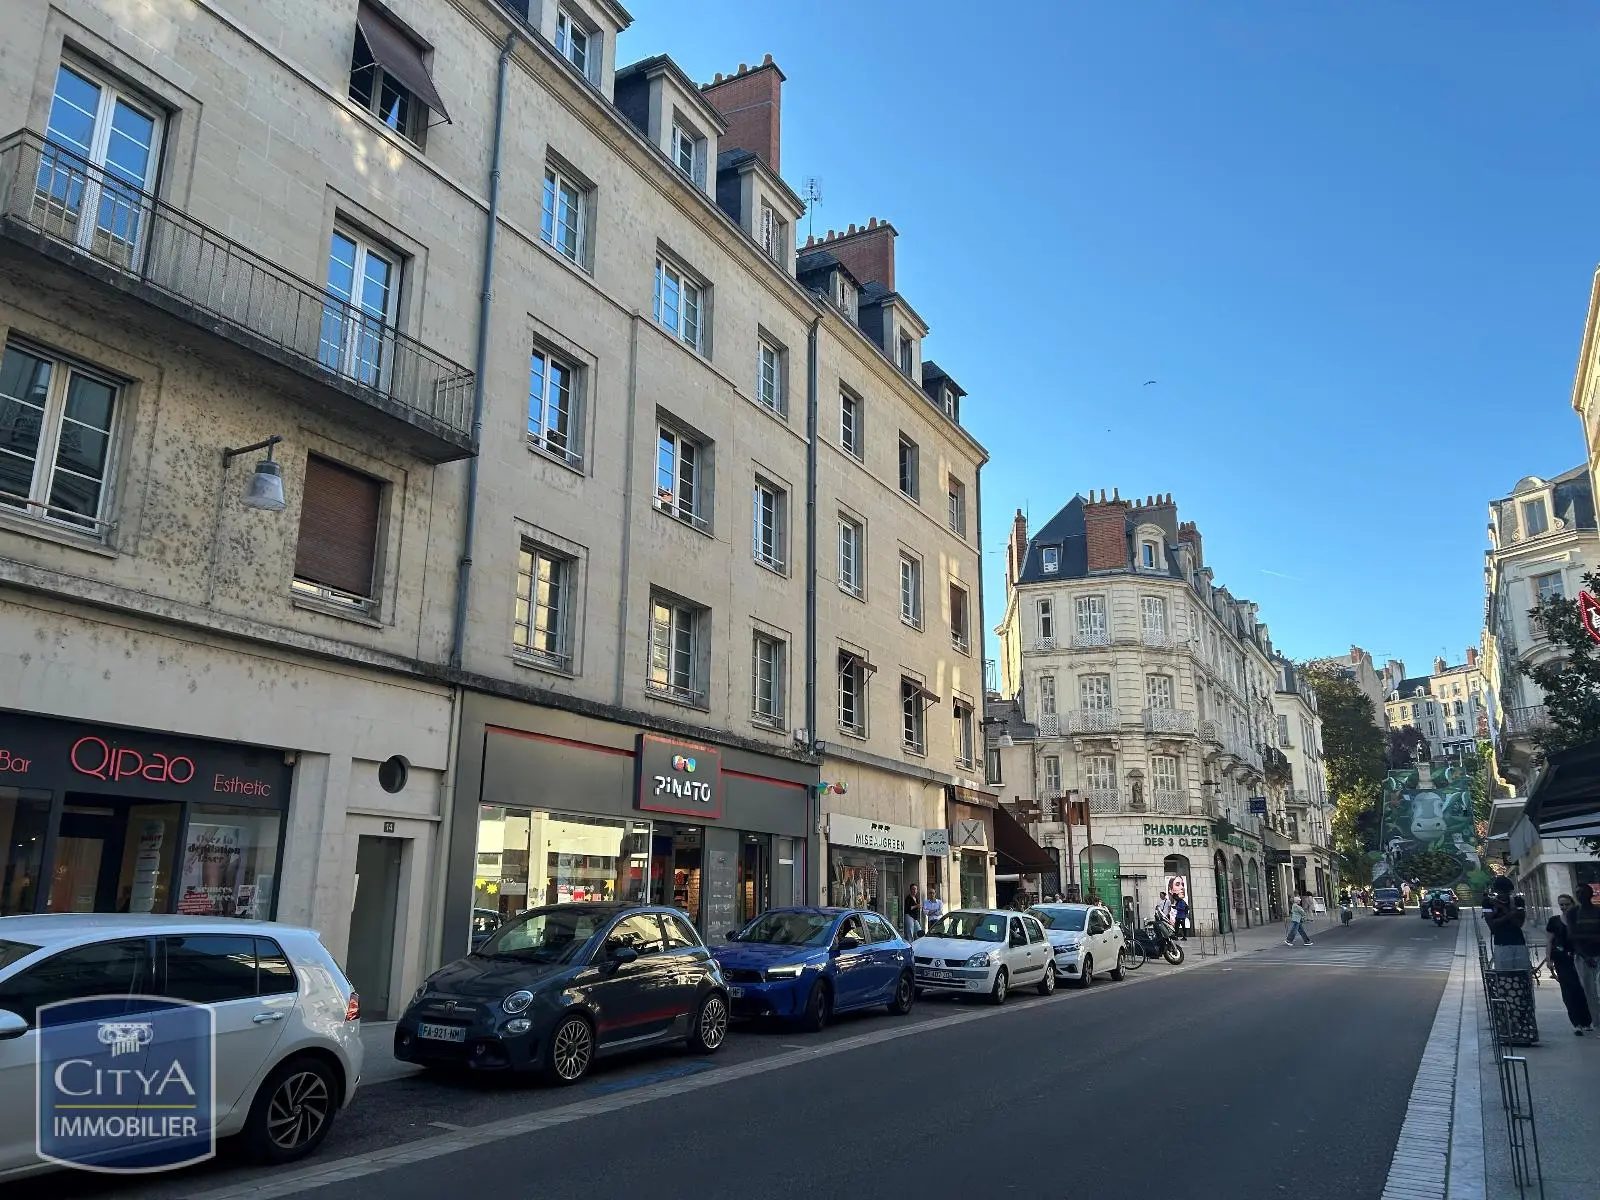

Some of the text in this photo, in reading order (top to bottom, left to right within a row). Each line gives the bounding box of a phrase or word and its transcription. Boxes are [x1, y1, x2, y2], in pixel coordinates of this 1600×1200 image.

[0, 749, 32, 773] Bar
[71, 736, 195, 784] Qipao
[213, 774, 271, 797] Esthetic
[1143, 823, 1209, 837] PHARMACIE
[1145, 837, 1209, 848] DES 3 CLEFS
